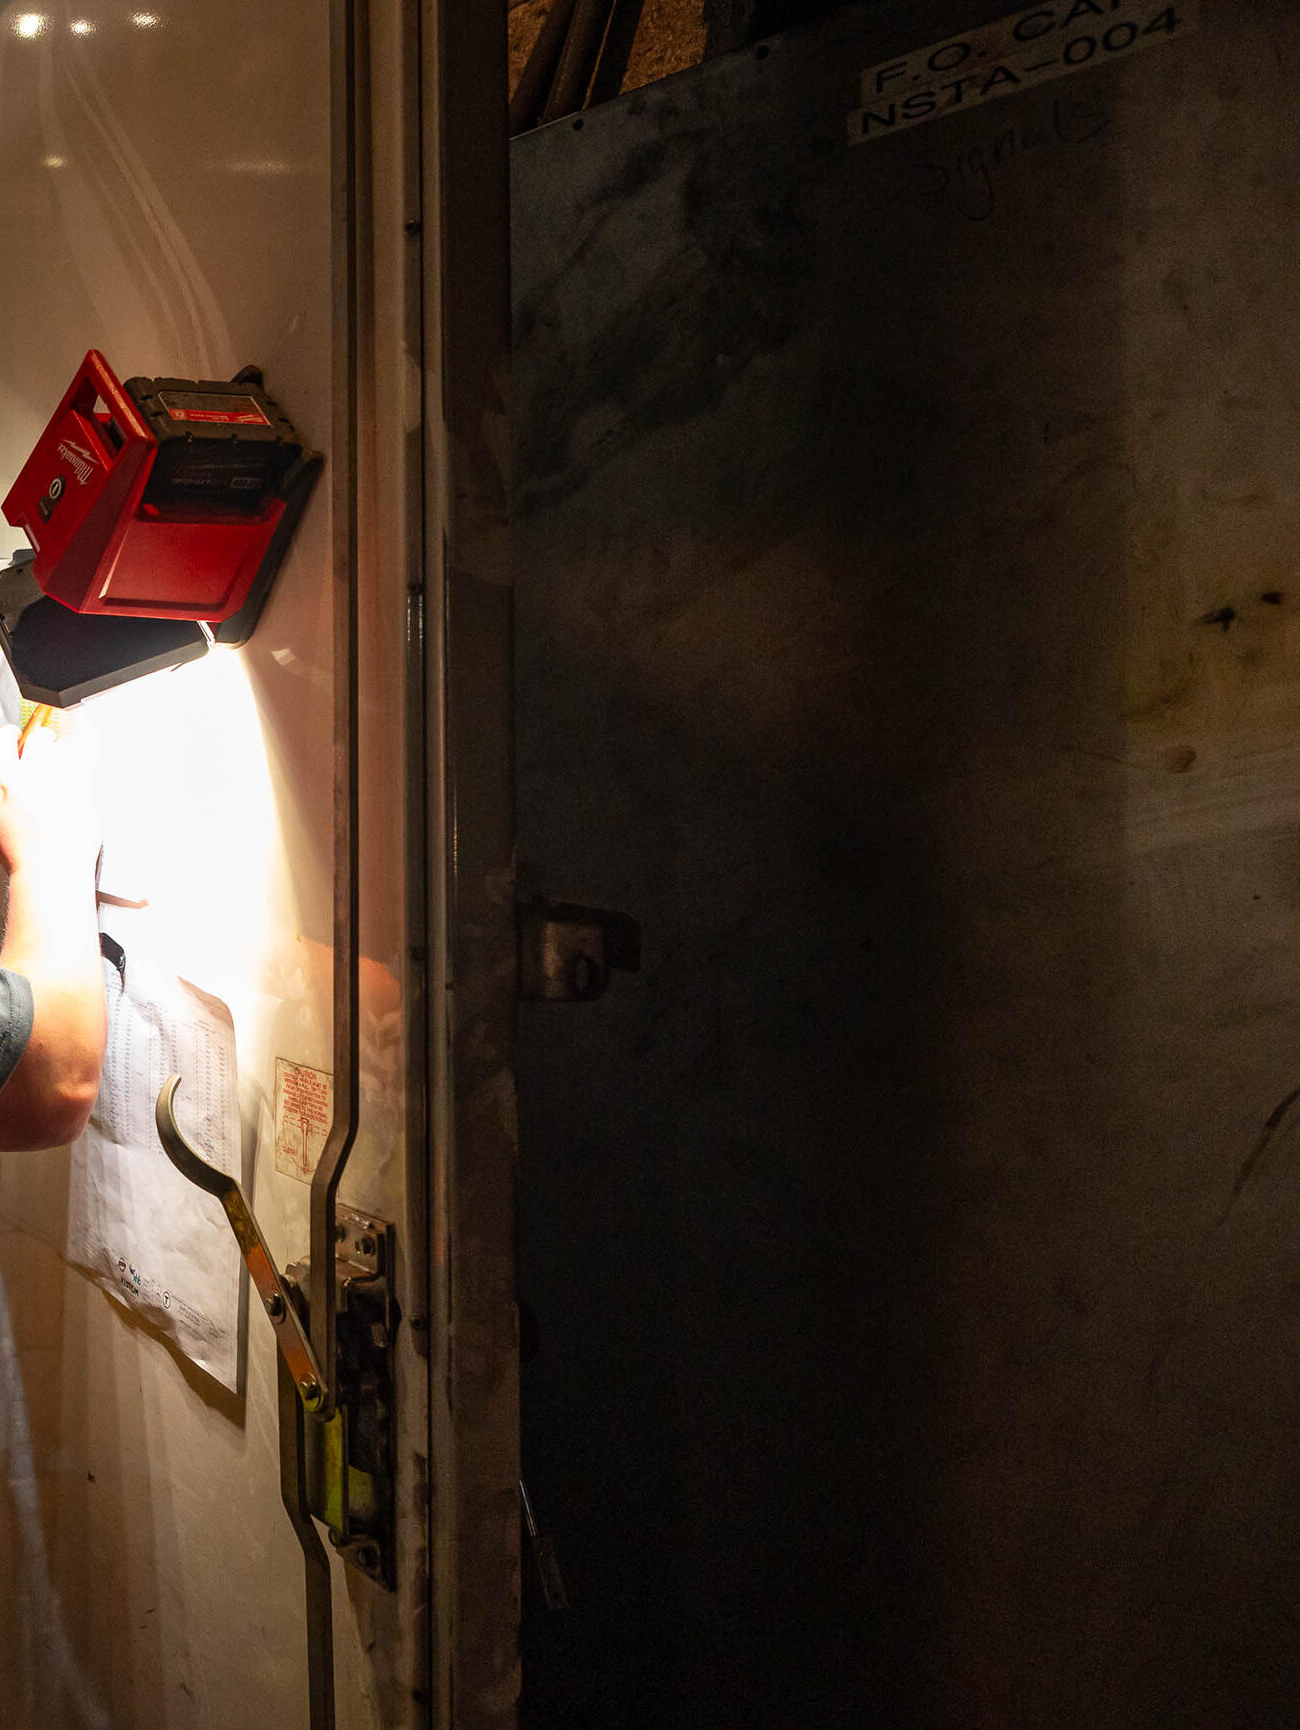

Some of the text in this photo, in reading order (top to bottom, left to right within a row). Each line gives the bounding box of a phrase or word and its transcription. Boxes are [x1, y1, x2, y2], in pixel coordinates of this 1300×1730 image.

[860, 6, 1182, 135] NSTA-004
[874, 0, 1120, 93] F.O. CA
[56, 442, 94, 486] Milwaukee
